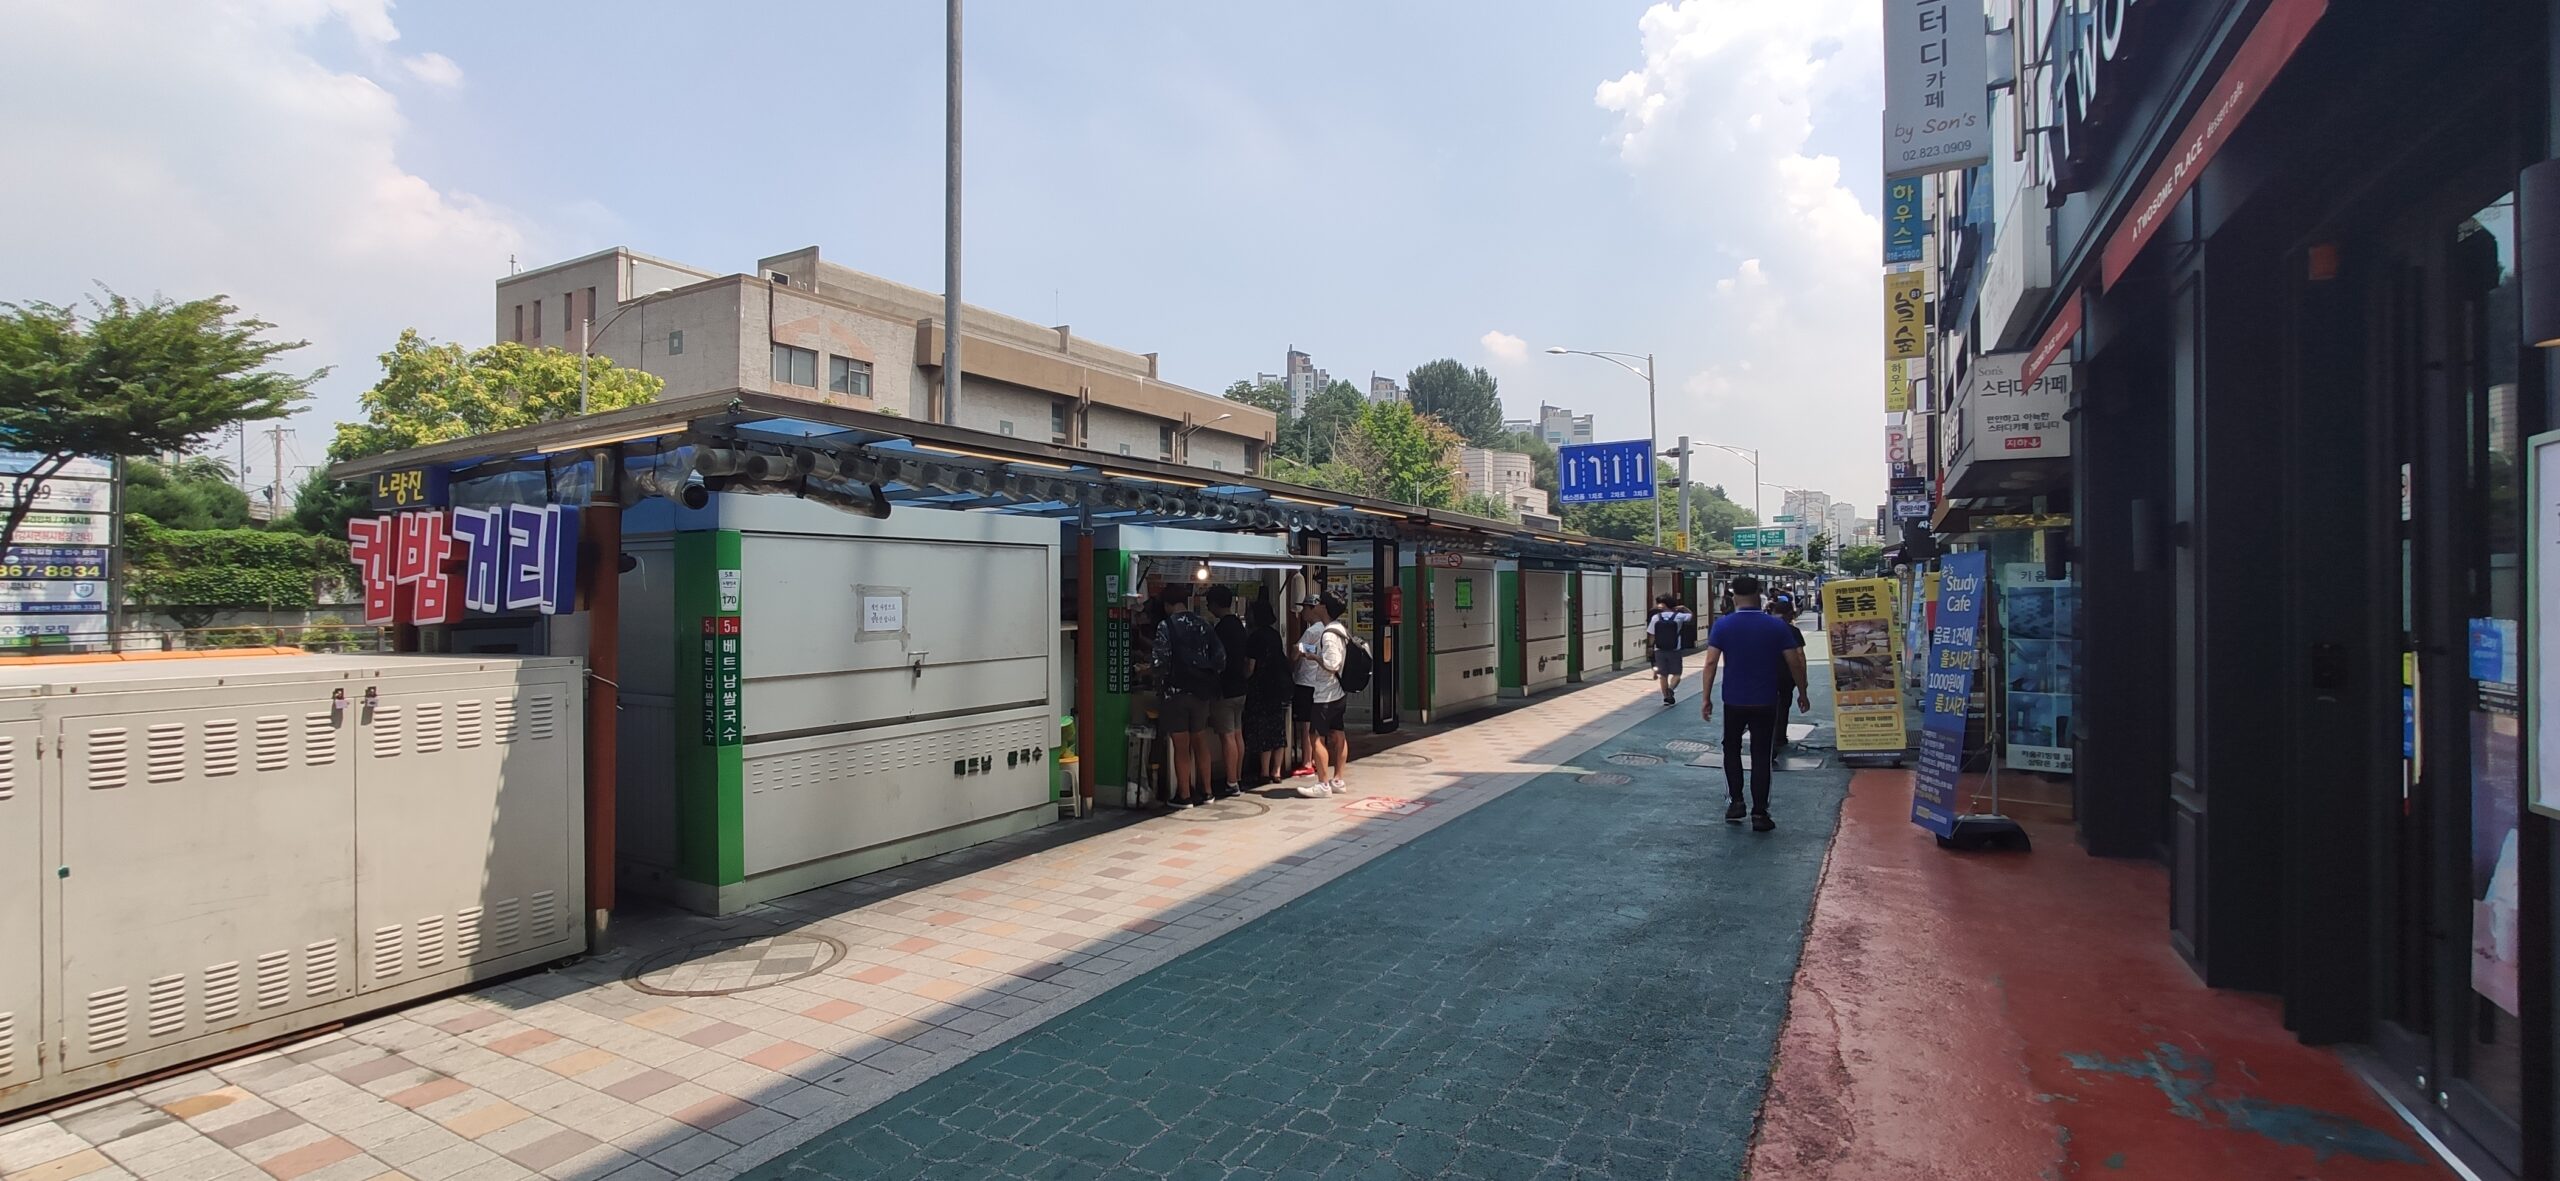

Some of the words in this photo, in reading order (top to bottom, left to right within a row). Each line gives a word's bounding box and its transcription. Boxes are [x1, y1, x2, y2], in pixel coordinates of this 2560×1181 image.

[1915, 0, 1948, 108] 터디카페
[1894, 124, 1913, 144] by
[1922, 112, 1976, 134] Son's
[1902, 139, 1972, 161] 02.823.0909
[2136, 176, 2174, 235] TWOSOME
[2174, 134, 2204, 186] PLACE
[1893, 185, 1913, 245] 하우스
[1890, 363, 1902, 395] 하우스
[2007, 438, 2028, 449] 지하
[378, 470, 424, 505] 노량진
[349, 511, 452, 626] 컵밥
[452, 503, 561, 614] 거리
[1946, 574, 1978, 594] Study
[722, 595, 737, 605] 170
[1836, 593, 1876, 613] 놀숲
[1947, 594, 1971, 612] Cafe
[723, 639, 737, 741] 베트남쌀국수
[1929, 672, 1966, 694] 1000원에
[954, 754, 992, 775] 베트남
